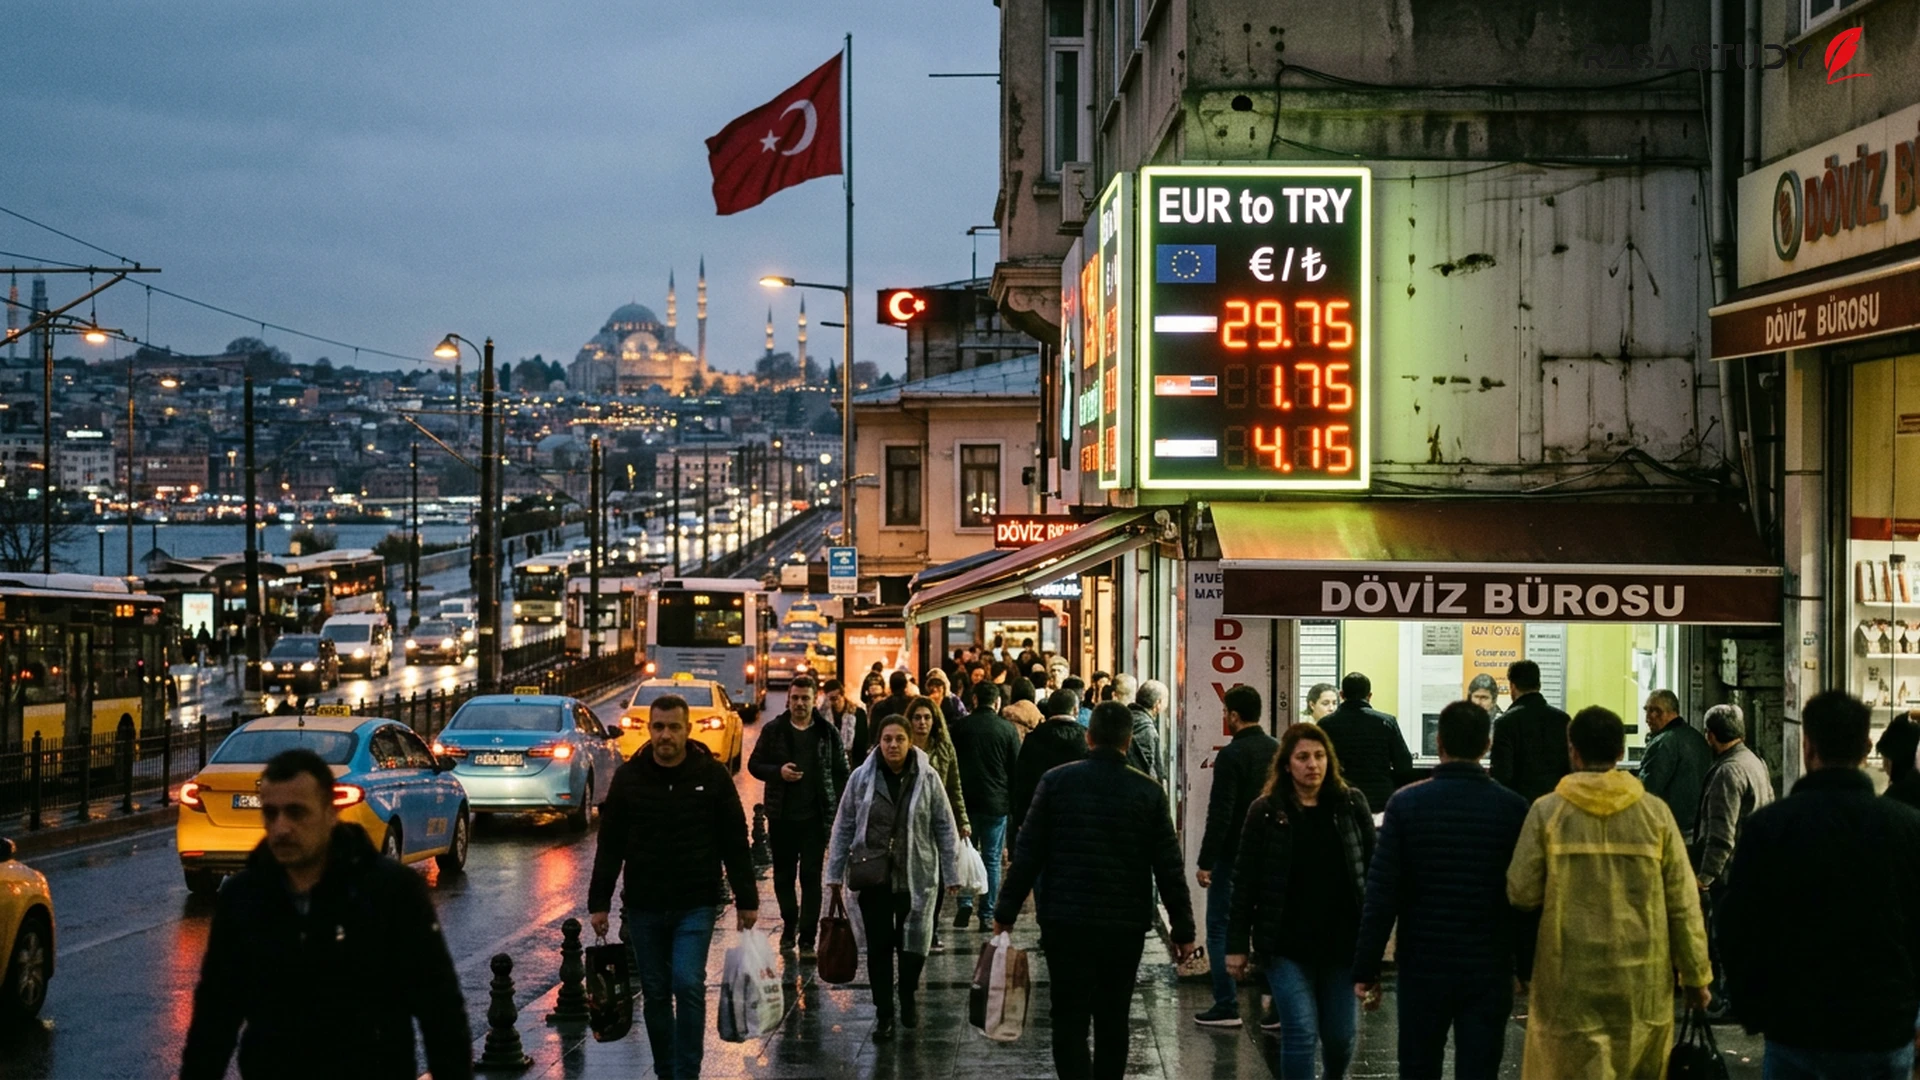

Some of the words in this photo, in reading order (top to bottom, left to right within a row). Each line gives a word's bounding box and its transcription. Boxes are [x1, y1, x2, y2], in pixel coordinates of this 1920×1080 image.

[1159, 186, 1232, 224] EUR
[1240, 187, 1275, 224] to
[1282, 187, 1353, 224] TRY
[1804, 143, 1888, 243] DÖVİZ
[1222, 301, 1354, 349] 29.75
[1765, 302, 1806, 346] DÖVİZ
[1816, 291, 1880, 338] BÜROSU
[1274, 363, 1353, 411] 1.75
[1254, 425, 1353, 473] 4.15
[997, 520, 1045, 542] DÖVİZ
[1321, 574, 1468, 614] DÖVİZ
[1484, 577, 1685, 617] BÜROSU
